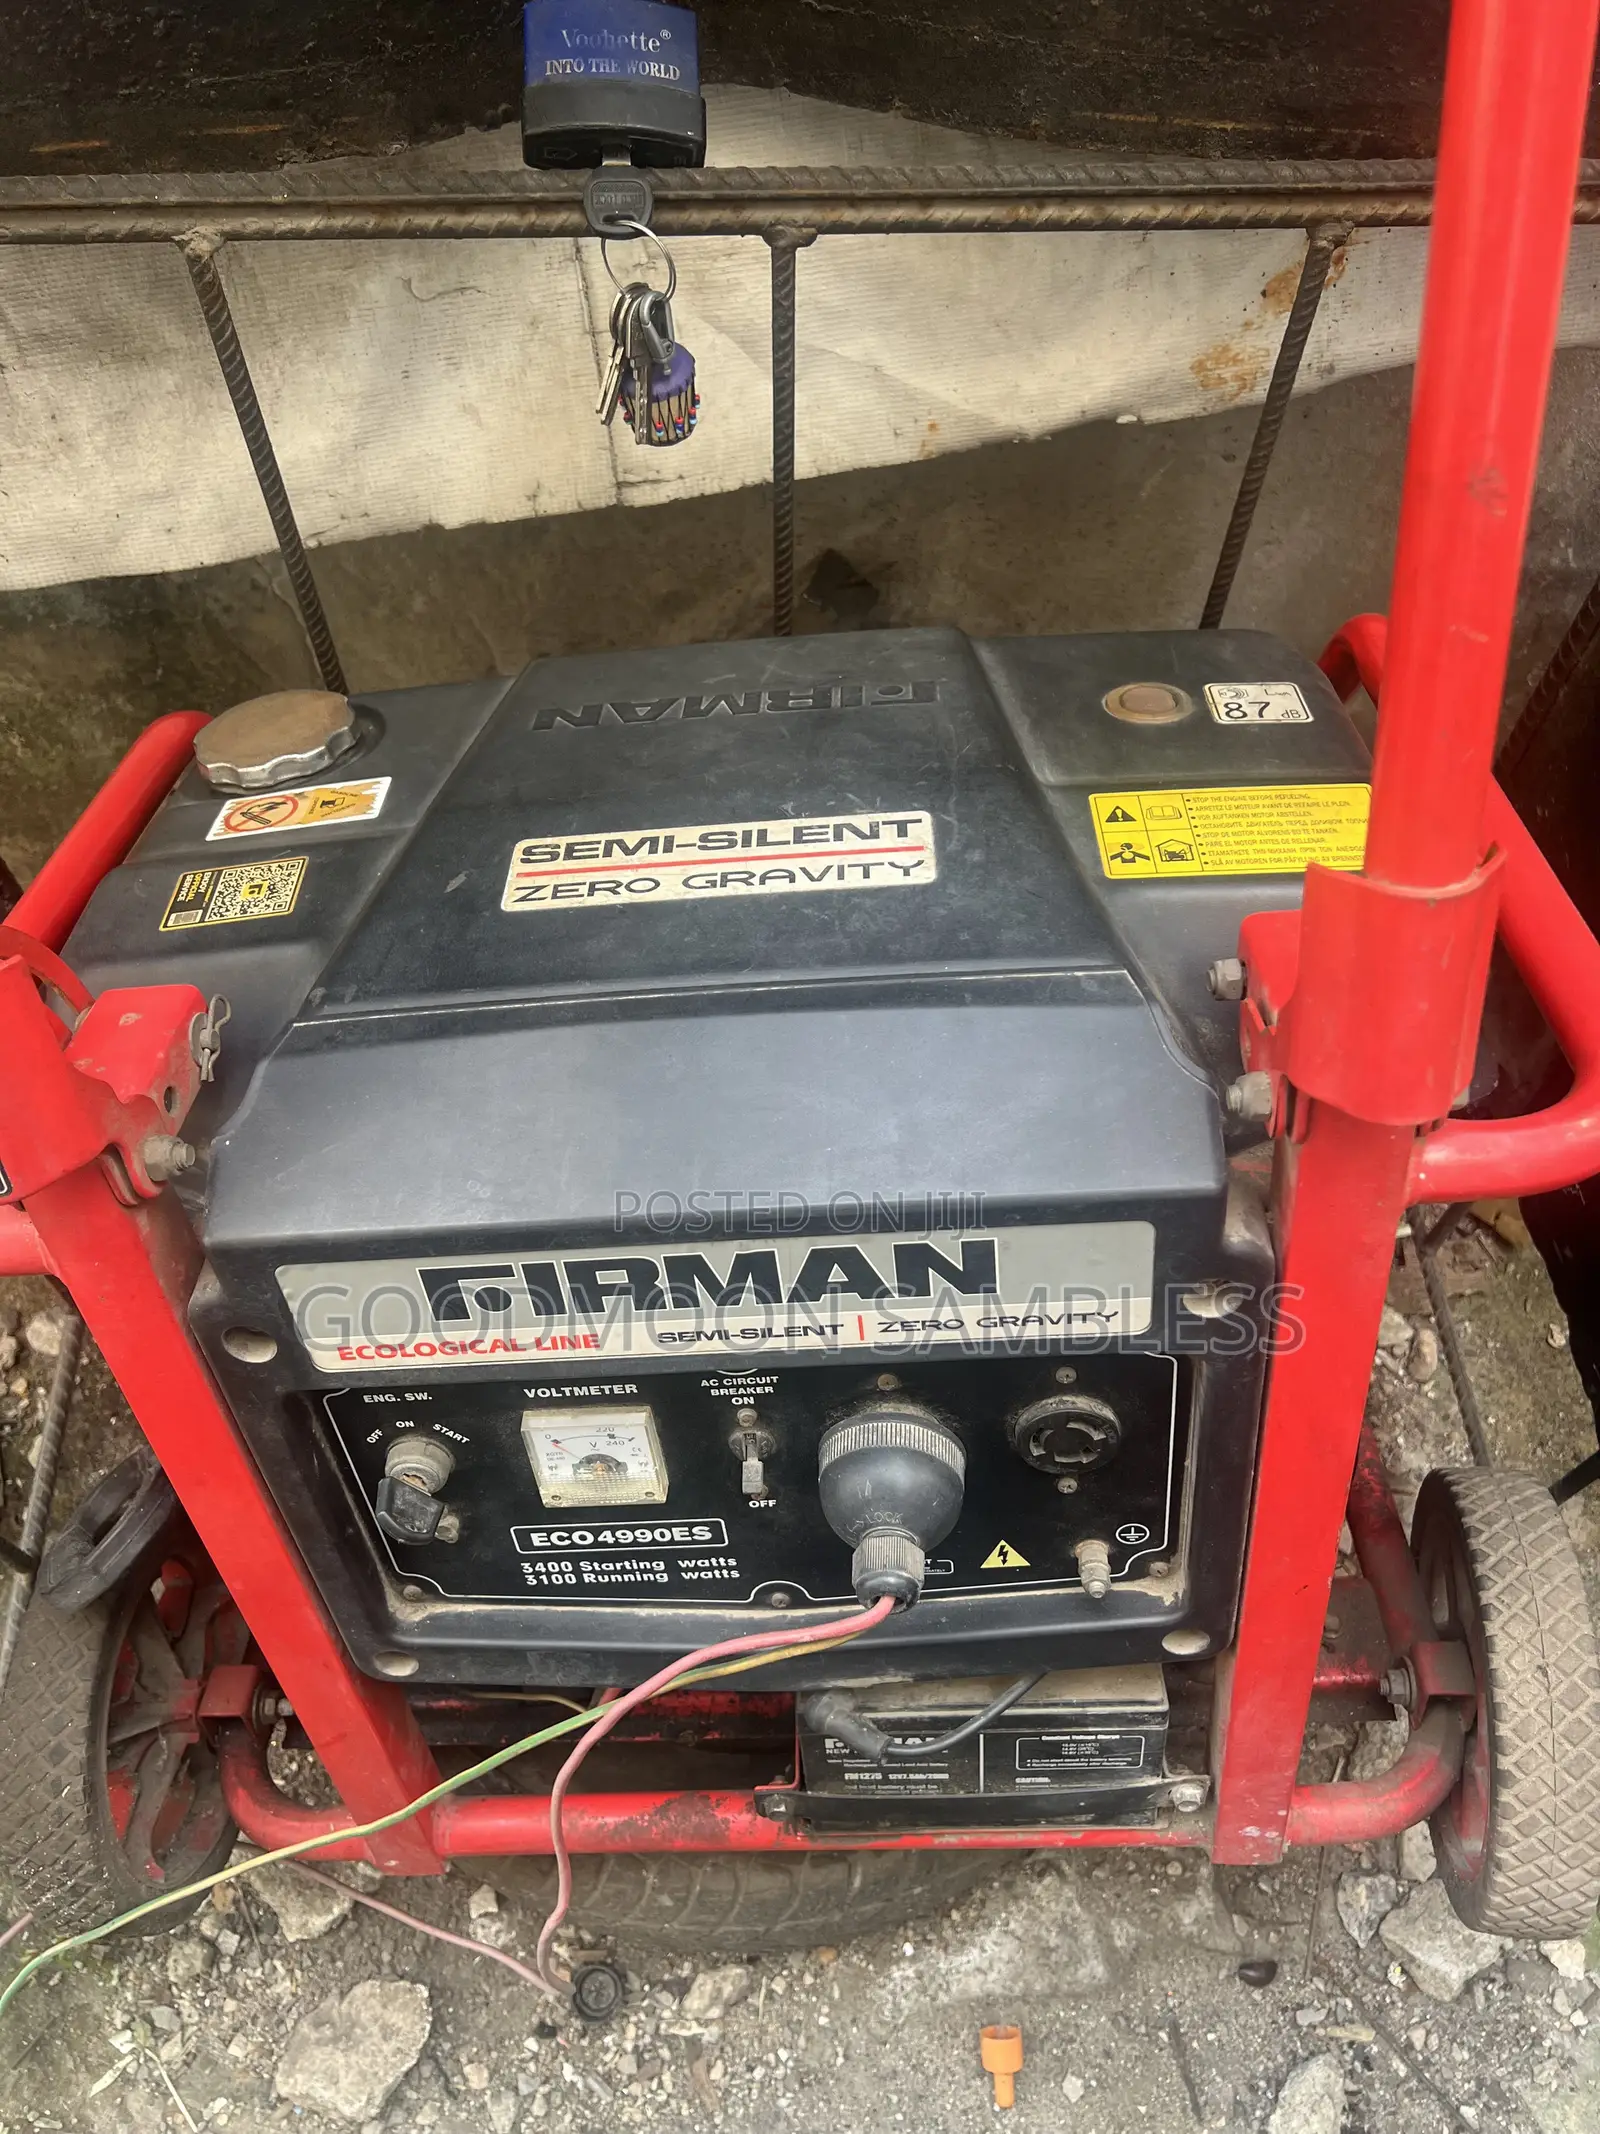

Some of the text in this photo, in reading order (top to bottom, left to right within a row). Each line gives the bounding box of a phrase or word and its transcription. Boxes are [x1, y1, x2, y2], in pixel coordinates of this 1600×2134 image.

[545, 57, 681, 81] INTO THE WORLD
[1223, 701, 1302, 719] 87 dB
[519, 817, 922, 864] SEMI-SILENT
[512, 859, 925, 904] ZERO GRAVITY
[416, 1236, 1001, 1322] FIRMAN
[337, 1311, 1119, 1362] ECOLOGICAL LINE SEMI-SILENT ZERO GRAVITY
[700, 1376, 779, 1387] AC CIRCUIT
[363, 1391, 433, 1404] ENG. SW.
[523, 1383, 639, 1399] VOLTMETER
[710, 1386, 774, 1396] BREAKER
[731, 1396, 755, 1405] ON
[365, 1420, 471, 1445] OFF ON START
[589, 1441, 597, 1449] V
[748, 1499, 777, 1508] OFF
[865, 1511, 904, 1525] LOCK
[529, 1525, 713, 1546] ECO4990ES
[520, 1556, 737, 1574] 3400 Starting watts
[525, 1567, 740, 1586] 3100 Running watts
